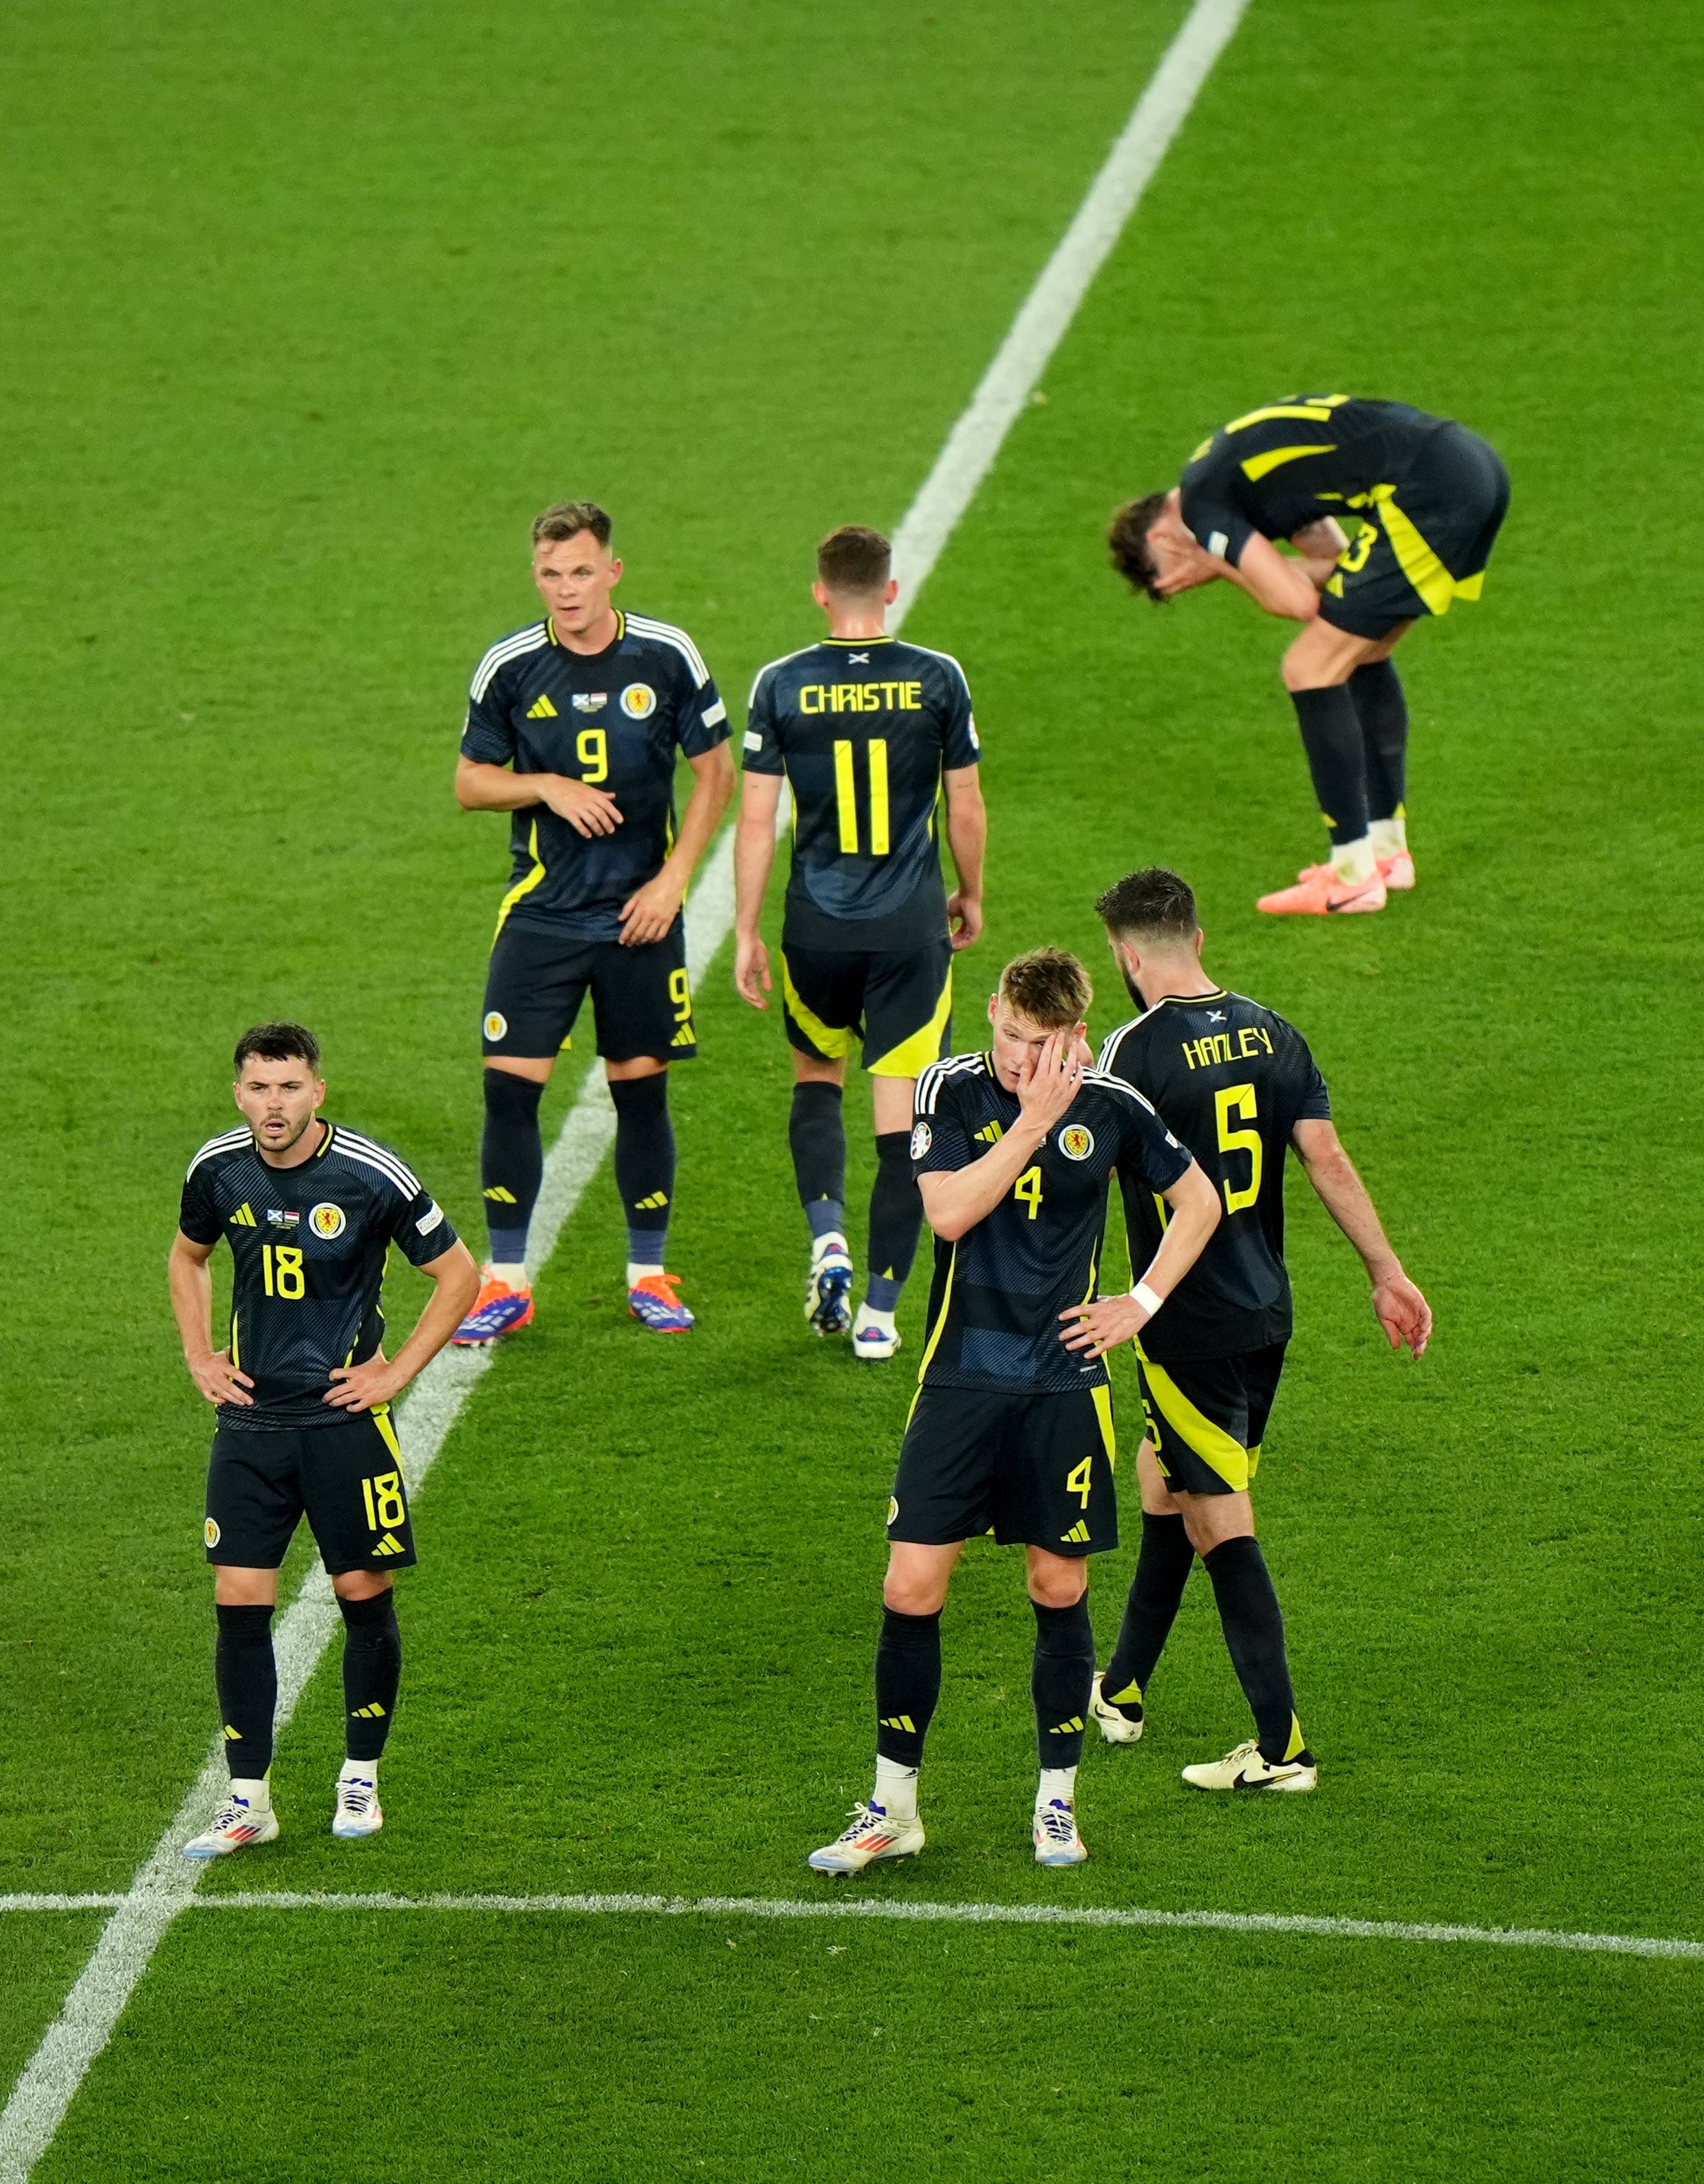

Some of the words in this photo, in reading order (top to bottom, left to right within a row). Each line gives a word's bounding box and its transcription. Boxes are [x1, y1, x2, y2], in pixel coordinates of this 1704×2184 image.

[800, 680, 922, 715] CHRISTIE
[576, 728, 608, 786] 9
[833, 739, 889, 856] 11
[669, 967, 692, 1022] 9
[1182, 1027, 1274, 1070] HANLEY
[1214, 1083, 1264, 1214] 5
[1013, 1165, 1044, 1220] 4
[261, 1244, 305, 1300] 18
[361, 1470, 406, 1531] 18
[1066, 1456, 1092, 1509] 4
